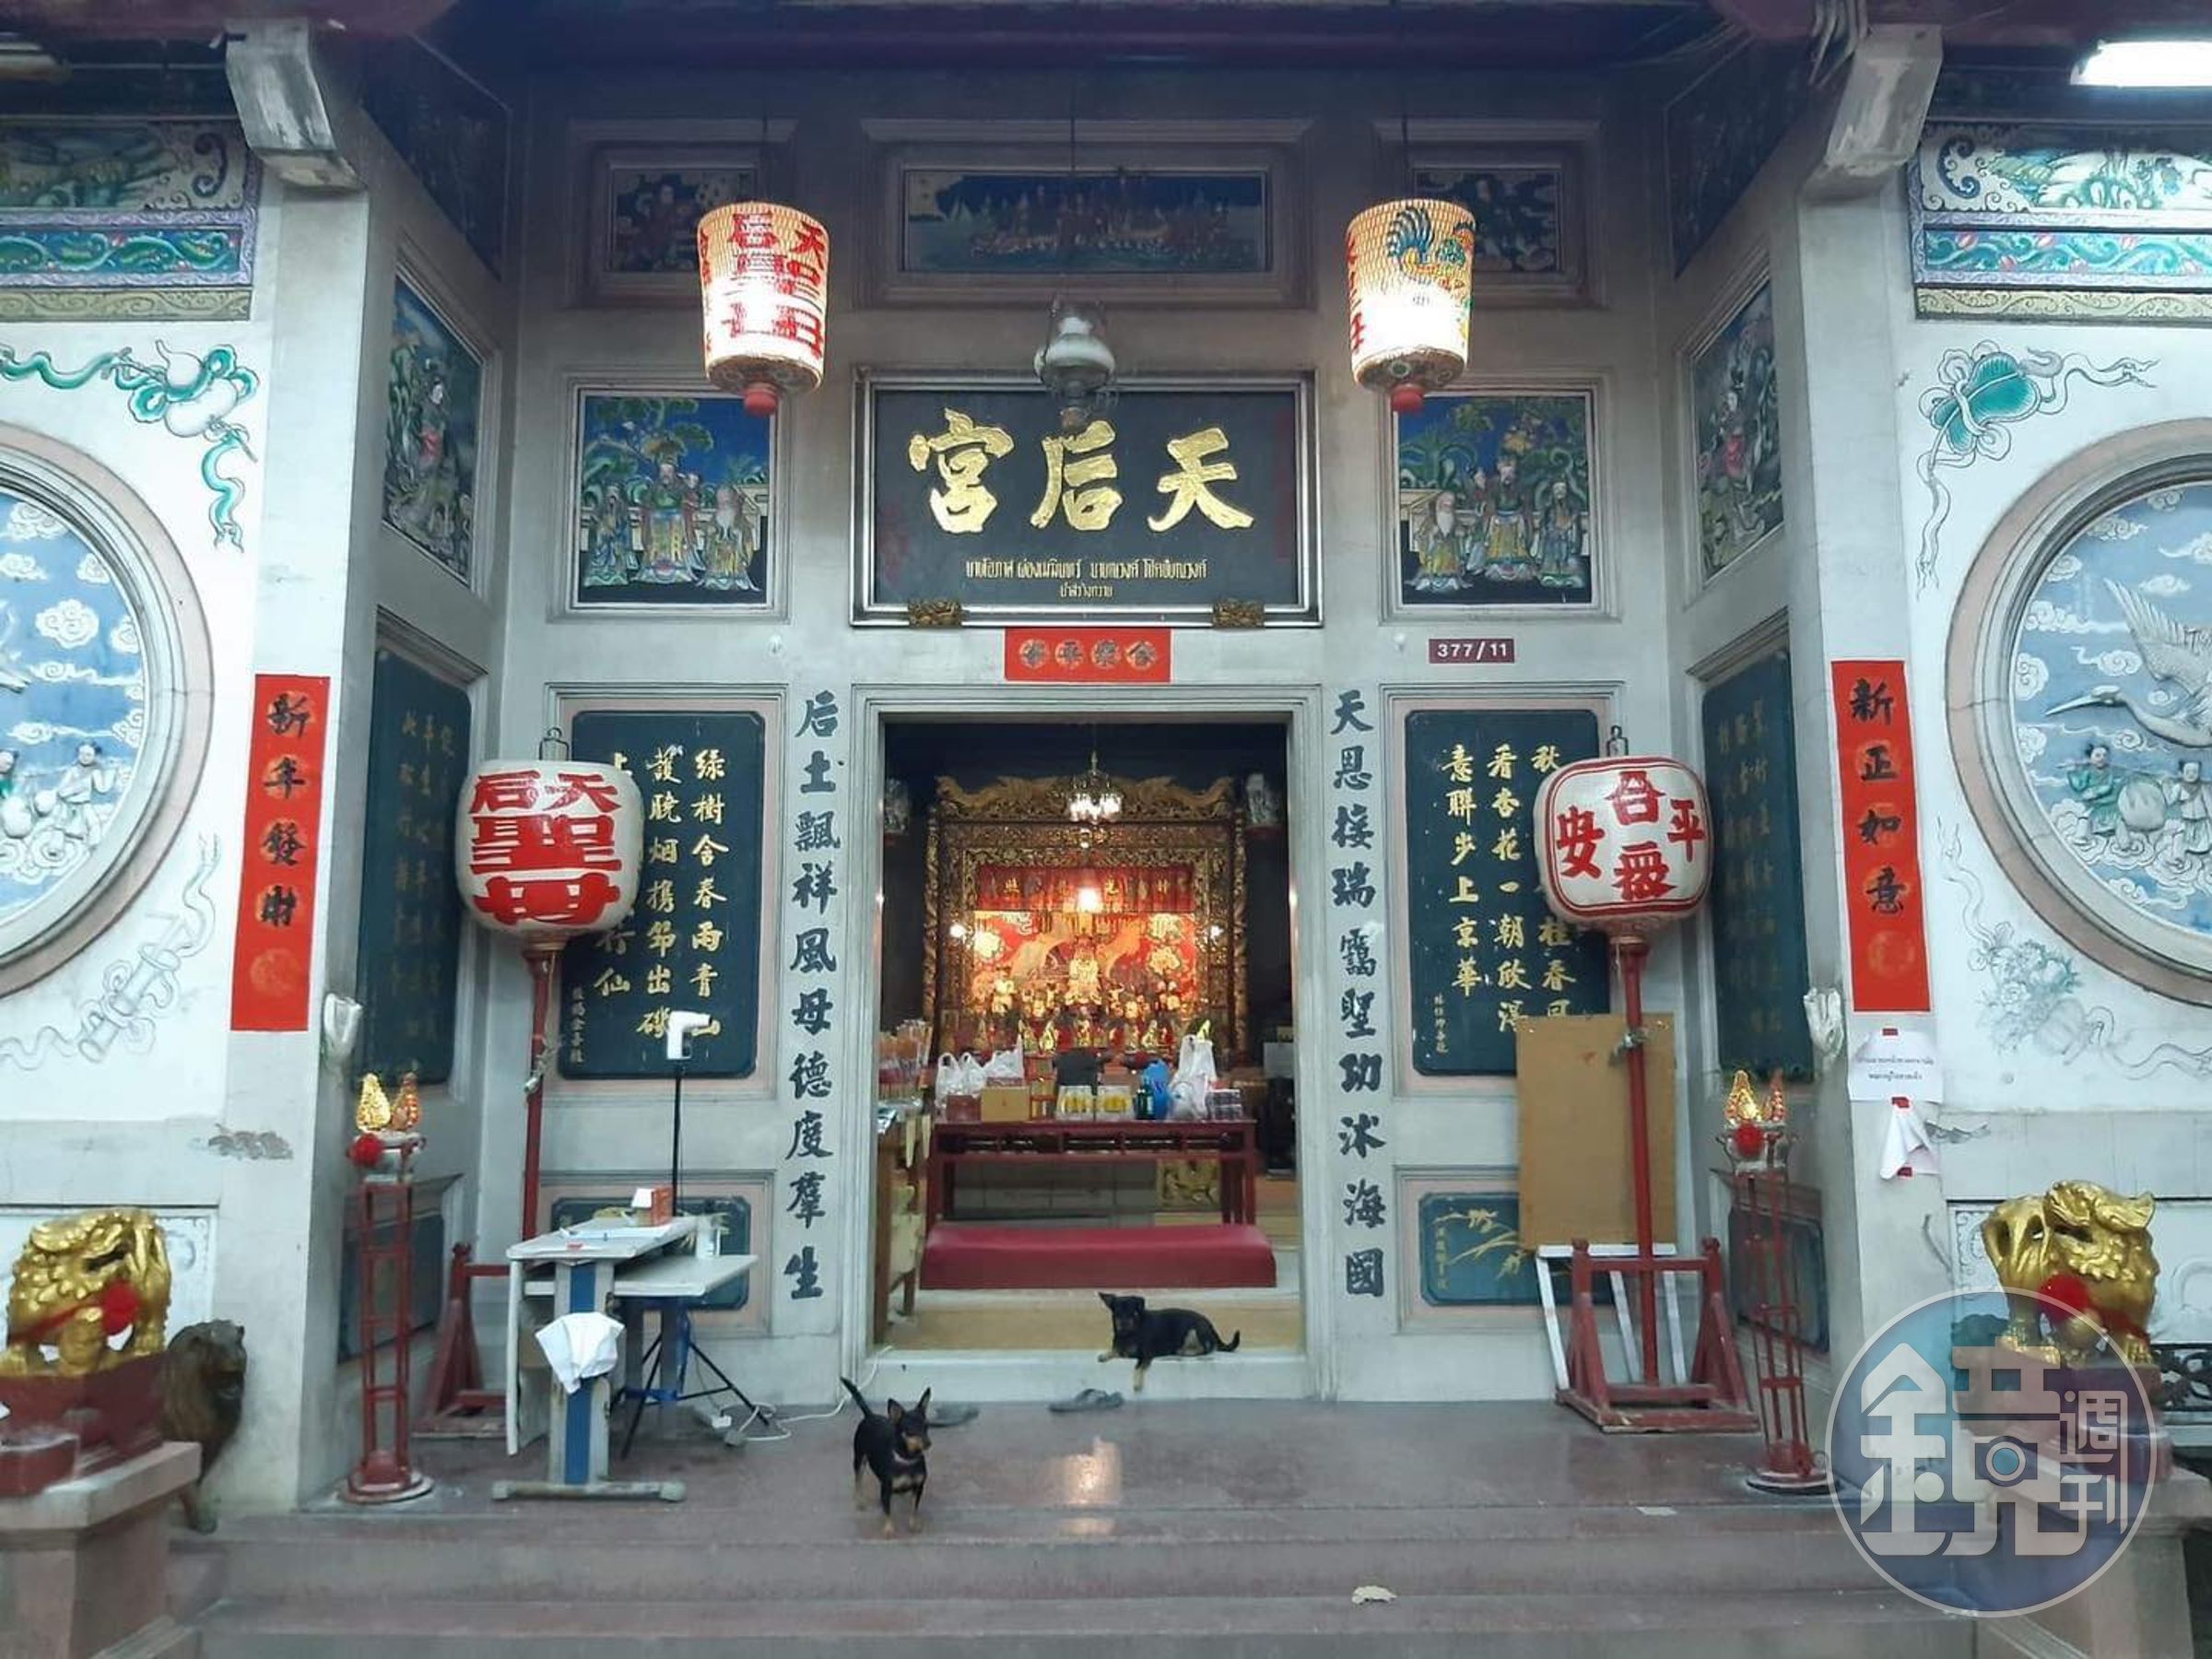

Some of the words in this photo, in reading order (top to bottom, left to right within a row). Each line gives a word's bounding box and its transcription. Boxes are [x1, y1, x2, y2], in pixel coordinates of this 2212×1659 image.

[1438, 641, 1506, 661] 377/11
[1849, 678, 1907, 915] 新正如意
